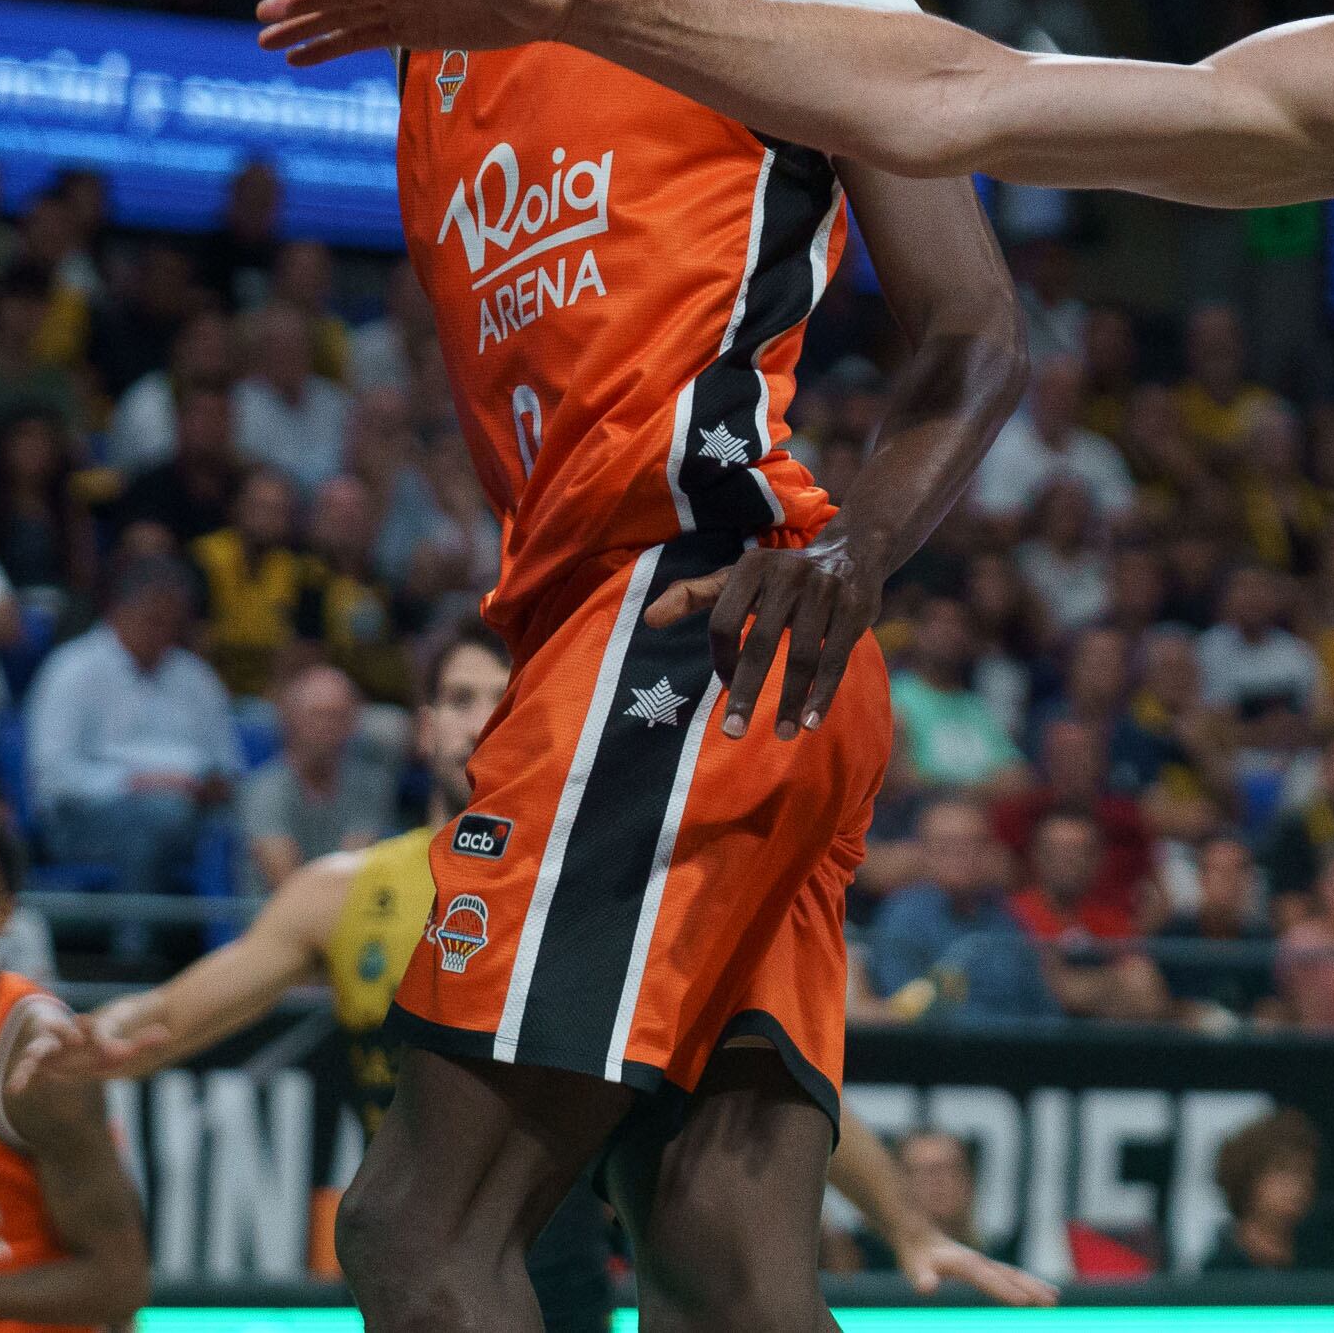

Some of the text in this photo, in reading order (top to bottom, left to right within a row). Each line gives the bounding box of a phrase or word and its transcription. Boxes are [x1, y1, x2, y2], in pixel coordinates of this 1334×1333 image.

[437, 142, 614, 274] Roig
[478, 249, 607, 355] ARENA
[458, 832, 494, 852] acb
